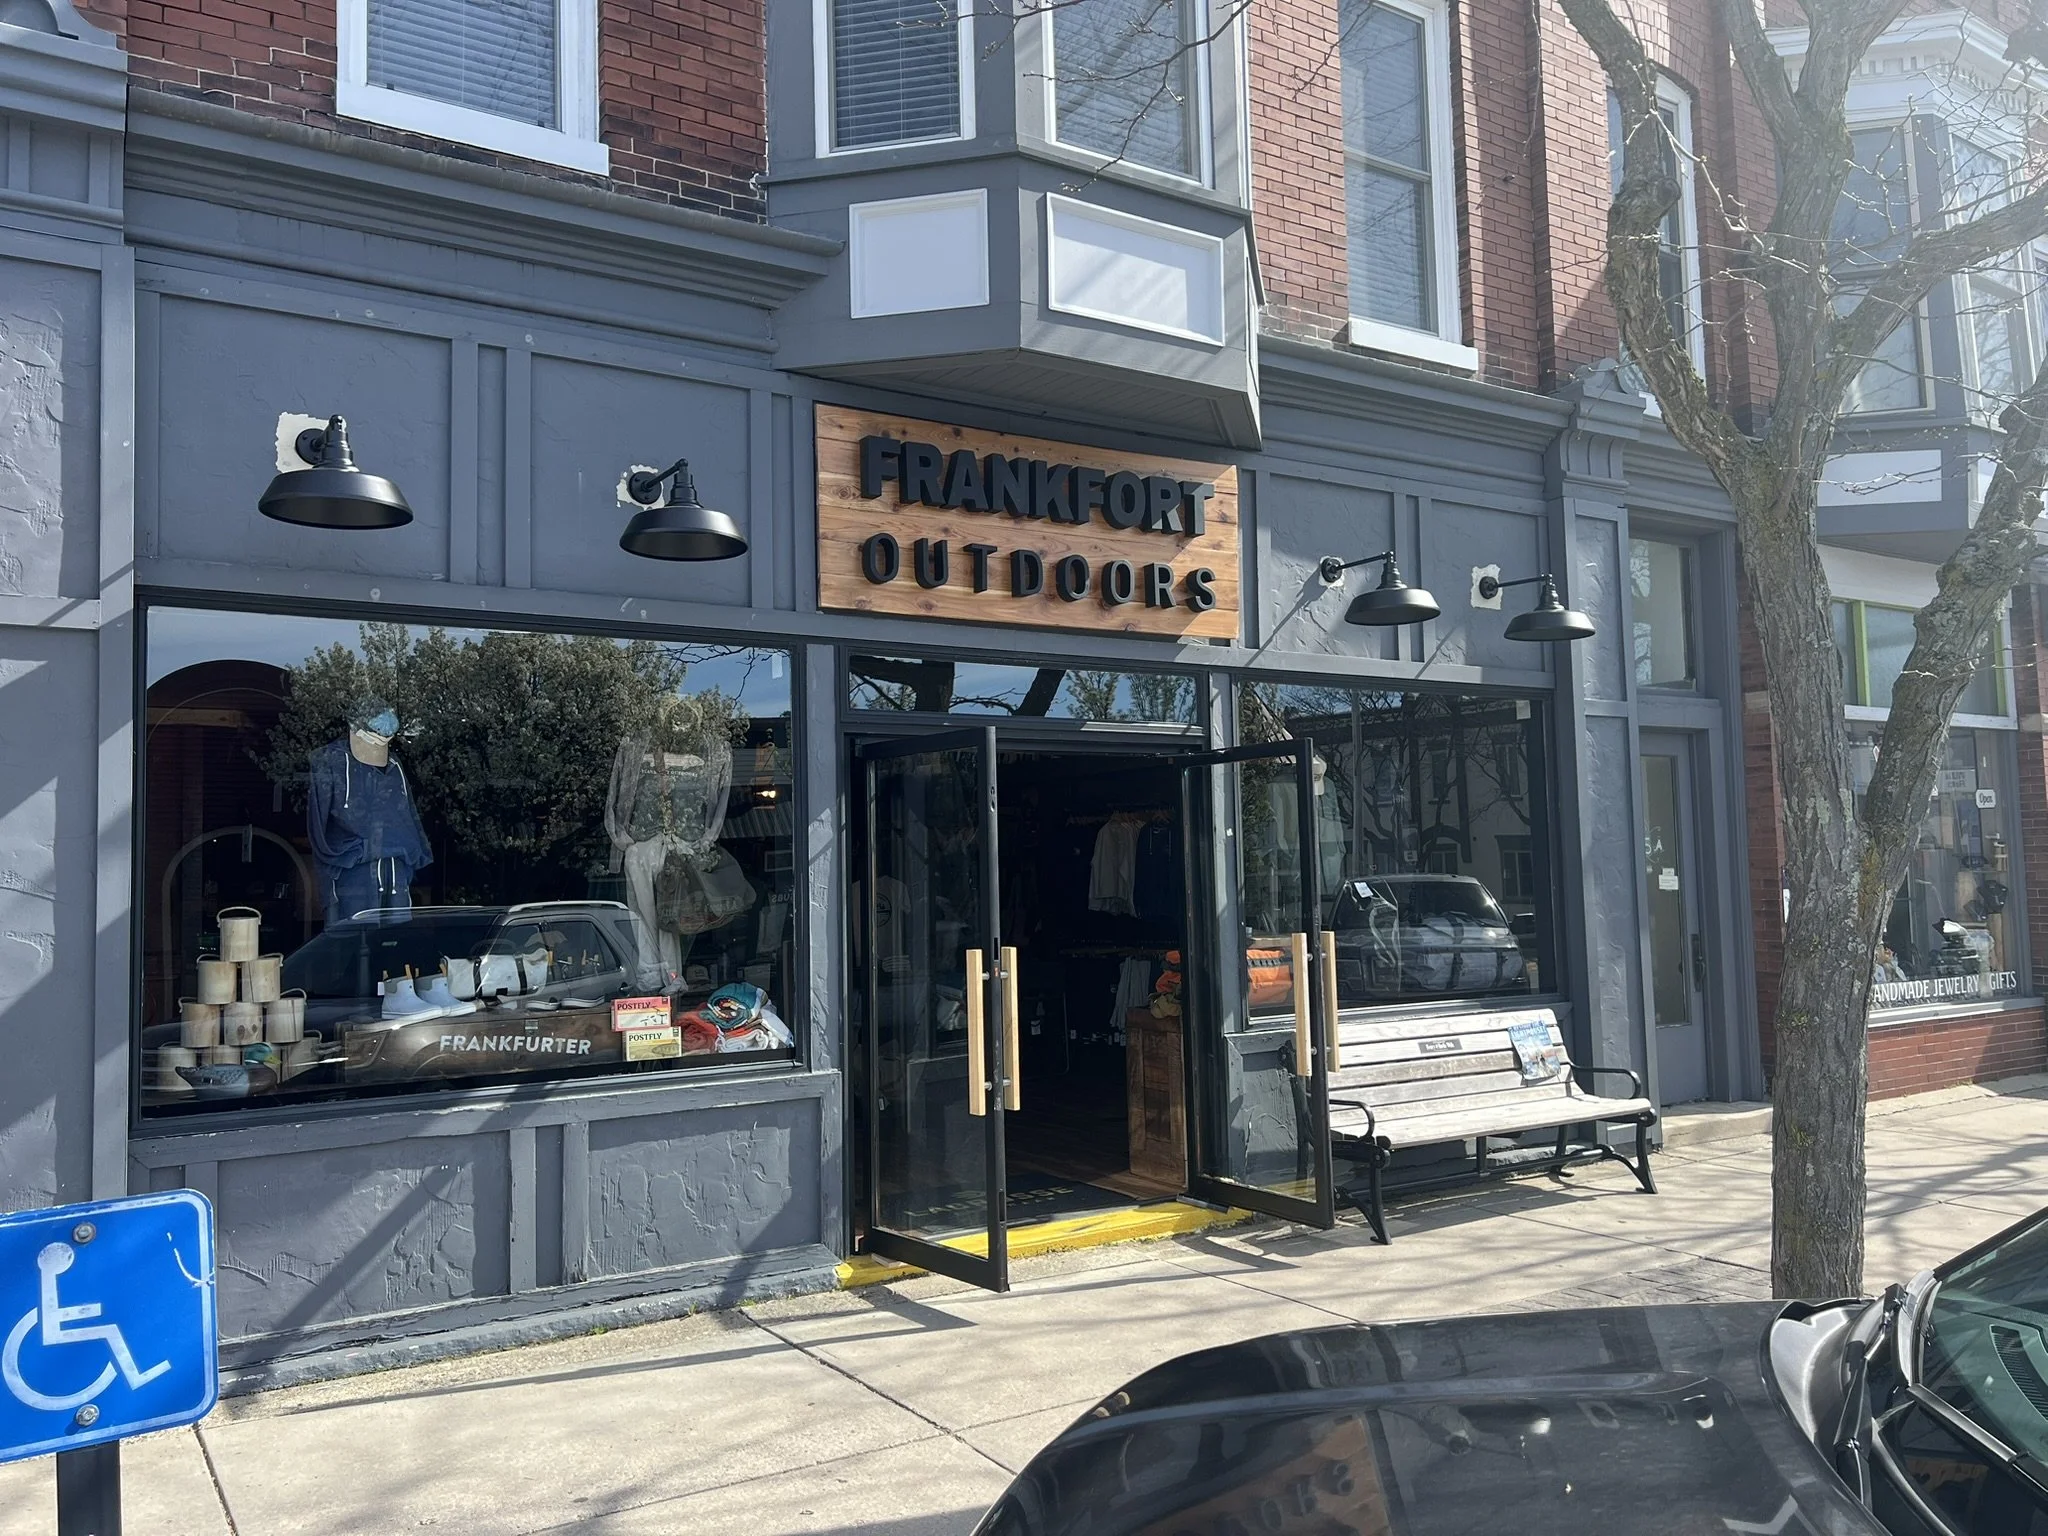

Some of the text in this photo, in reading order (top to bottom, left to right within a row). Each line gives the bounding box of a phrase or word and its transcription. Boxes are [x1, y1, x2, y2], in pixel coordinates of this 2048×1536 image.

[859, 435, 1215, 537] FRANKFORT
[861, 532, 1216, 613] OUTDOORS
[1979, 792, 1994, 806] Open
[1872, 971, 2017, 1002] ANDMADE JEWELRY GIFTS
[617, 1001, 651, 1011] POSTFLY
[439, 1034, 592, 1055] FRANKFURTER
[628, 1032, 663, 1042] POSTFLY
